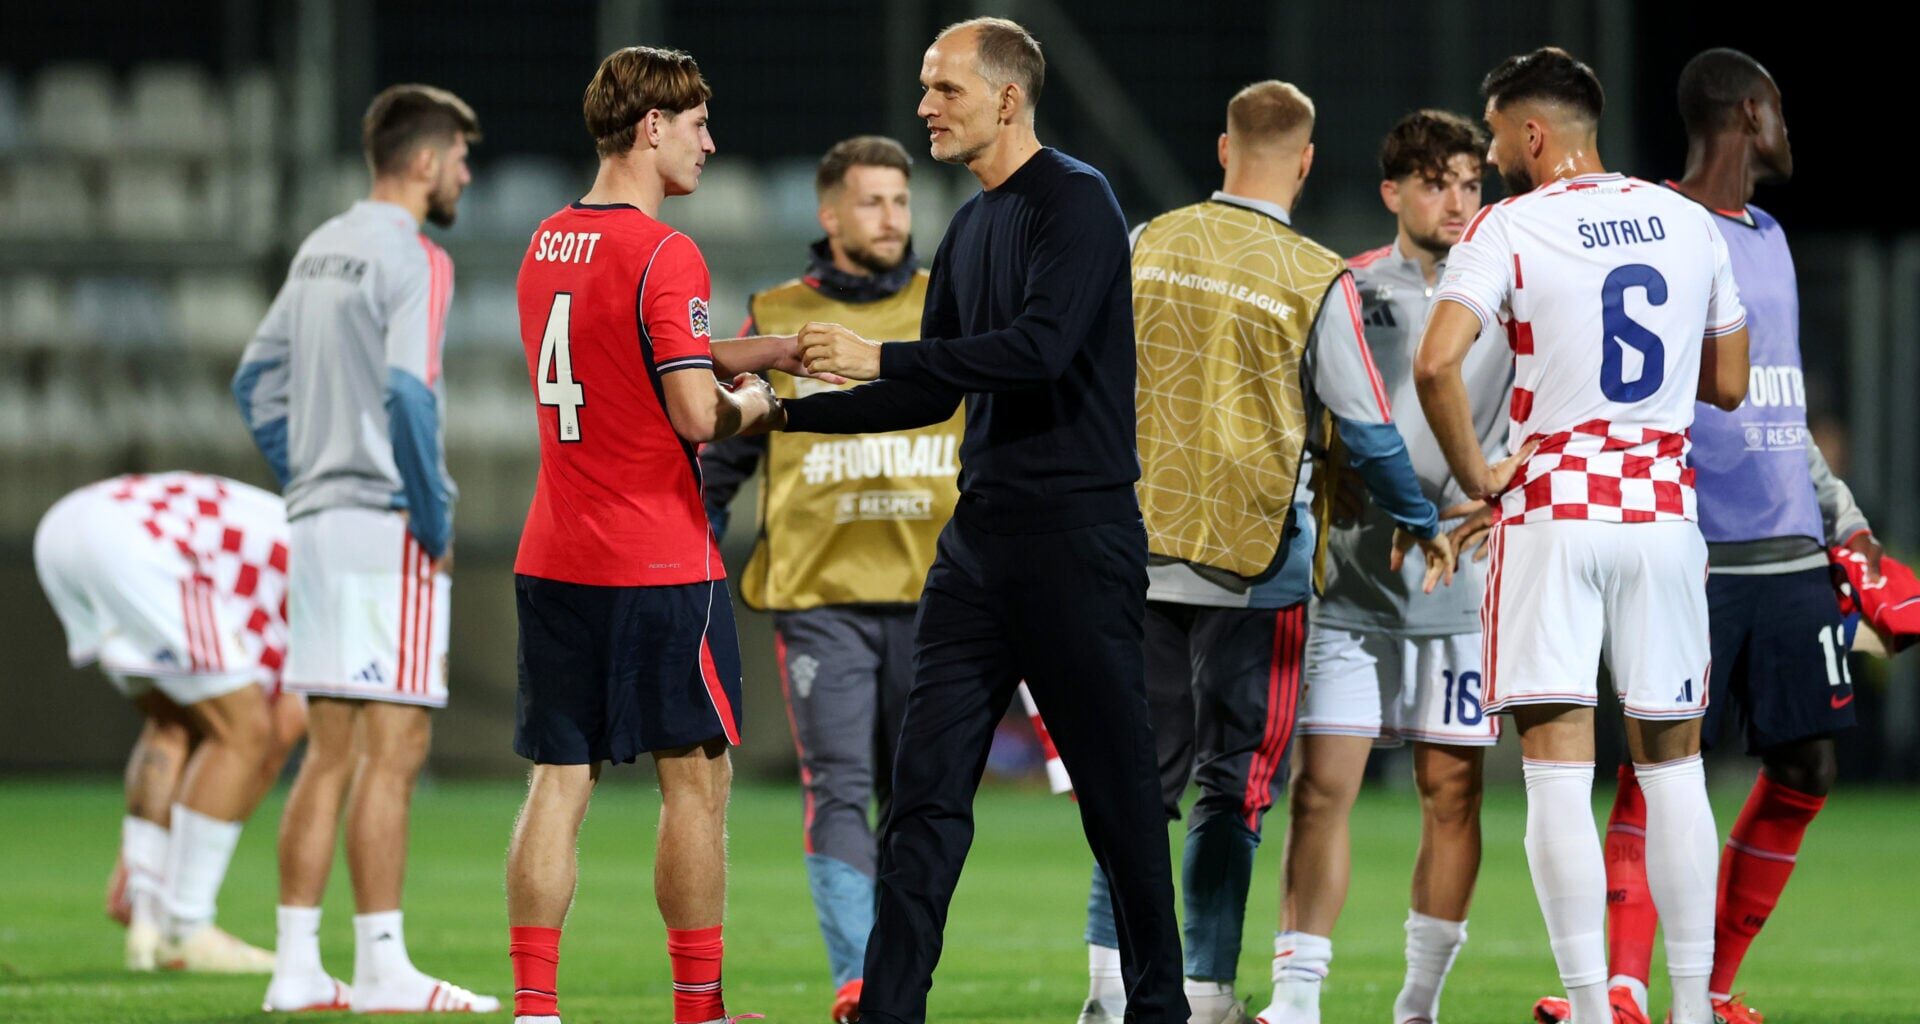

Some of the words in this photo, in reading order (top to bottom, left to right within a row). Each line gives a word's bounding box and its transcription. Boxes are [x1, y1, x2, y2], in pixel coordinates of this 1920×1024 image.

[535, 230, 602, 264] SCOTT
[1577, 216, 1666, 249] ŠUTALO
[1135, 266, 1167, 282] UEFA
[1168, 271, 1229, 297] NATIONS
[1228, 283, 1293, 321] LEAGUE
[1600, 263, 1669, 403] 6
[537, 291, 586, 443] 4
[802, 434, 958, 485] #FOOTBALL
[858, 494, 932, 514] RESPECT
[1443, 670, 1483, 726] 16
